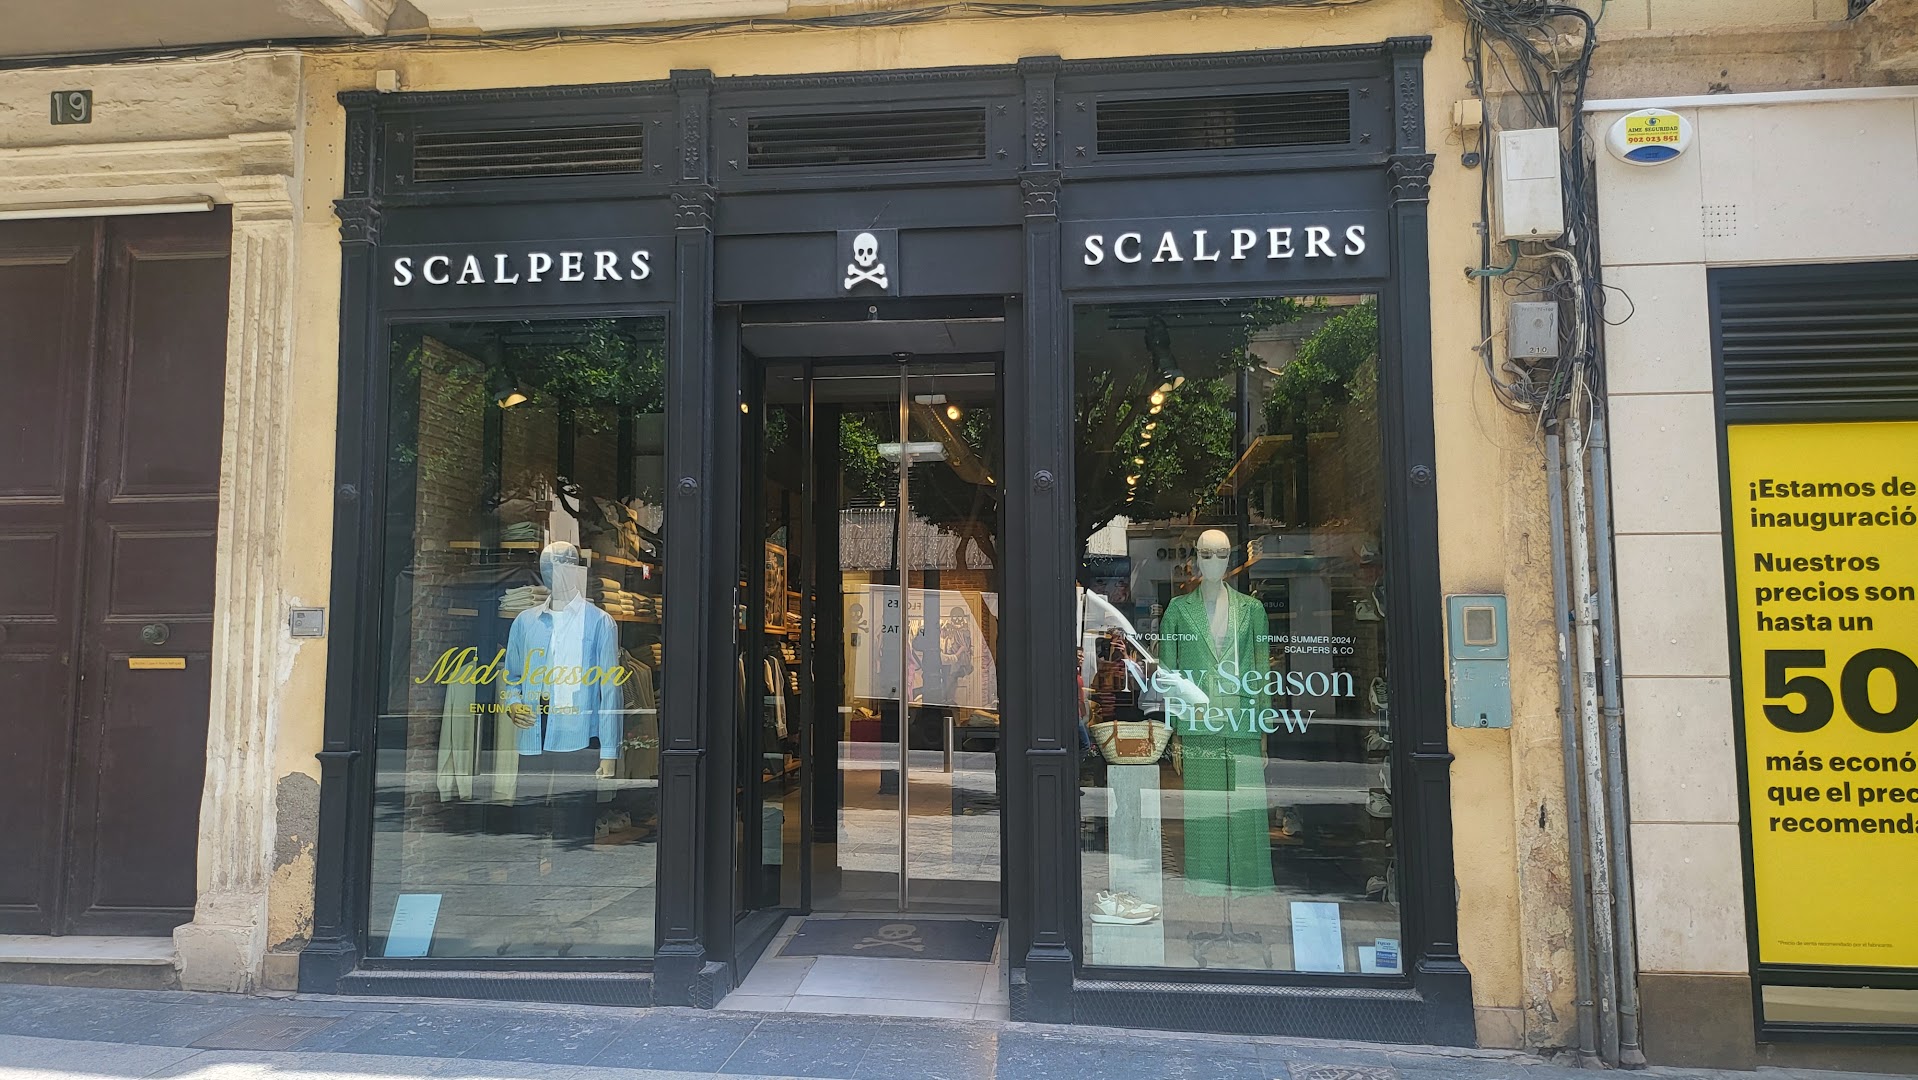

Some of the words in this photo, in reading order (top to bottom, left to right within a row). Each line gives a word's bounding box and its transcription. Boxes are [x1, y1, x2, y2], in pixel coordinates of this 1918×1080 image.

[53, 92, 87, 122] 19
[1645, 135, 1661, 143] 023
[1084, 225, 1366, 266] SCALPERS
[393, 250, 651, 287] SCALPERS
[1748, 478, 1876, 502] ¡Estamos
[1881, 476, 1917, 497] de
[1750, 505, 1918, 532] inauguració
[1753, 552, 1881, 573] Nuestros
[1755, 581, 1860, 607] precios
[1864, 585, 1916, 602] son
[1756, 611, 1833, 632] hasta
[1837, 615, 1874, 632] un
[1144, 633, 1198, 641] COLLECTION
[1256, 635, 1289, 643] SPRING
[1291, 635, 1329, 644] SUMMER
[1331, 636, 1351, 644] 2024
[1284, 645, 1330, 654] SCALPERS
[1332, 646, 1338, 654] &
[1340, 646, 1354, 654] CO
[414, 646, 506, 686] Mid
[502, 648, 634, 687] Season
[1120, 658, 1208, 694] New
[1216, 660, 1356, 698] Season
[1761, 647, 1918, 734] 50
[469, 703, 485, 713] EN
[487, 703, 512, 714] UNA
[1162, 696, 1316, 735] Preview
[1765, 750, 1824, 772] más
[1828, 750, 1917, 773] econó
[1767, 785, 1821, 807] que
[1825, 781, 1851, 803] el
[1858, 786, 1918, 807] prec
[1769, 813, 1918, 834] recomend
